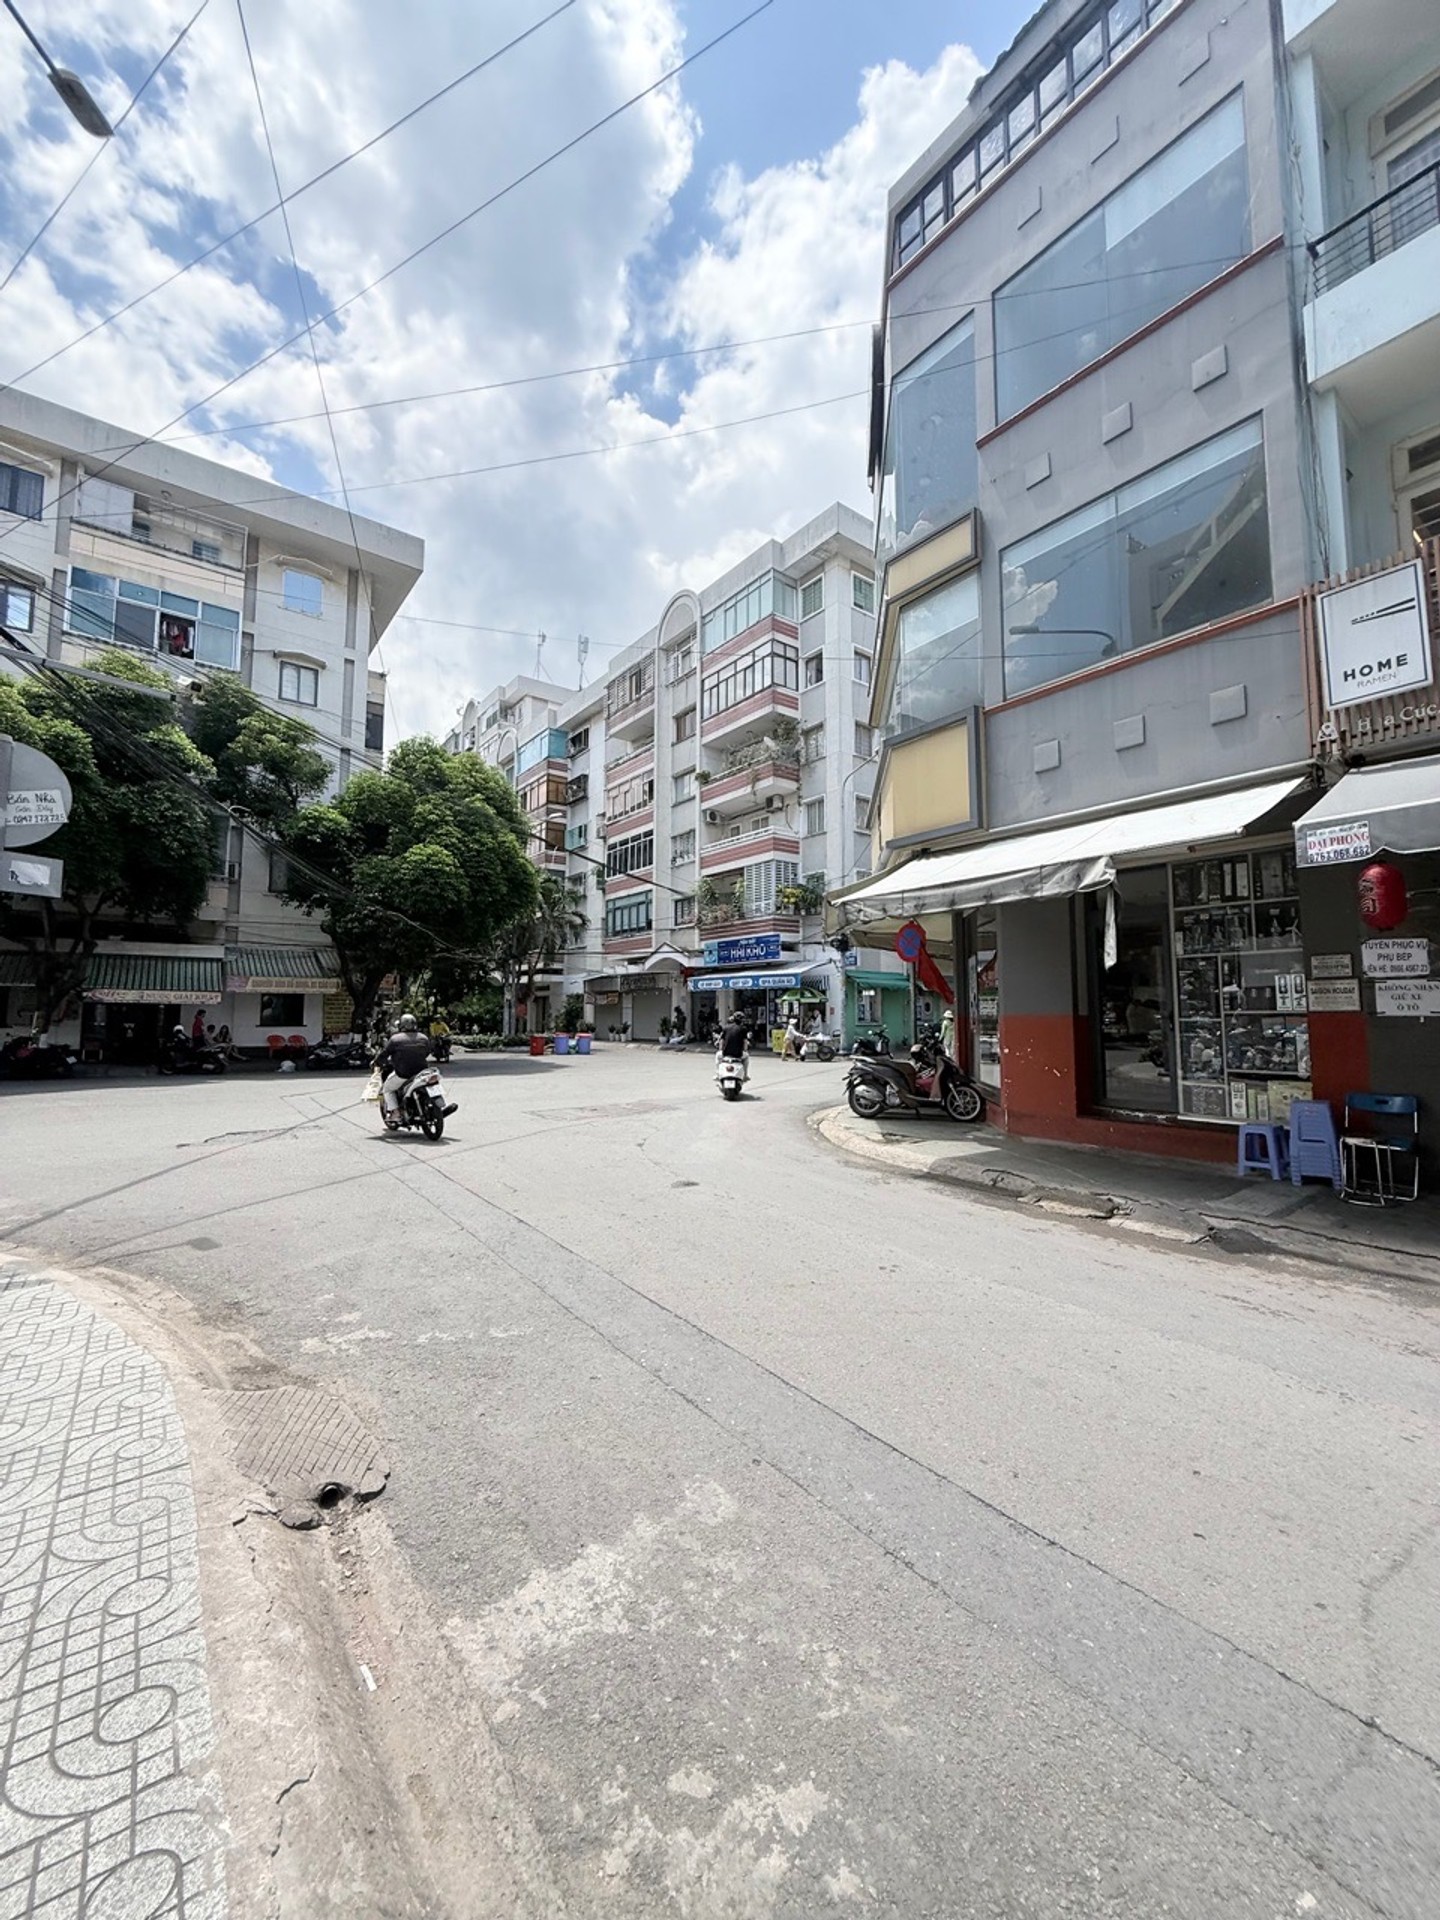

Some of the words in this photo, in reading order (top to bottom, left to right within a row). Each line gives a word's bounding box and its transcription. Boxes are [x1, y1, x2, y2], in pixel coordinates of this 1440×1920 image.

[1343, 653, 1408, 682] HOME
[1356, 671, 1397, 688] RAMEN
[1329, 831, 1370, 847] PHONG
